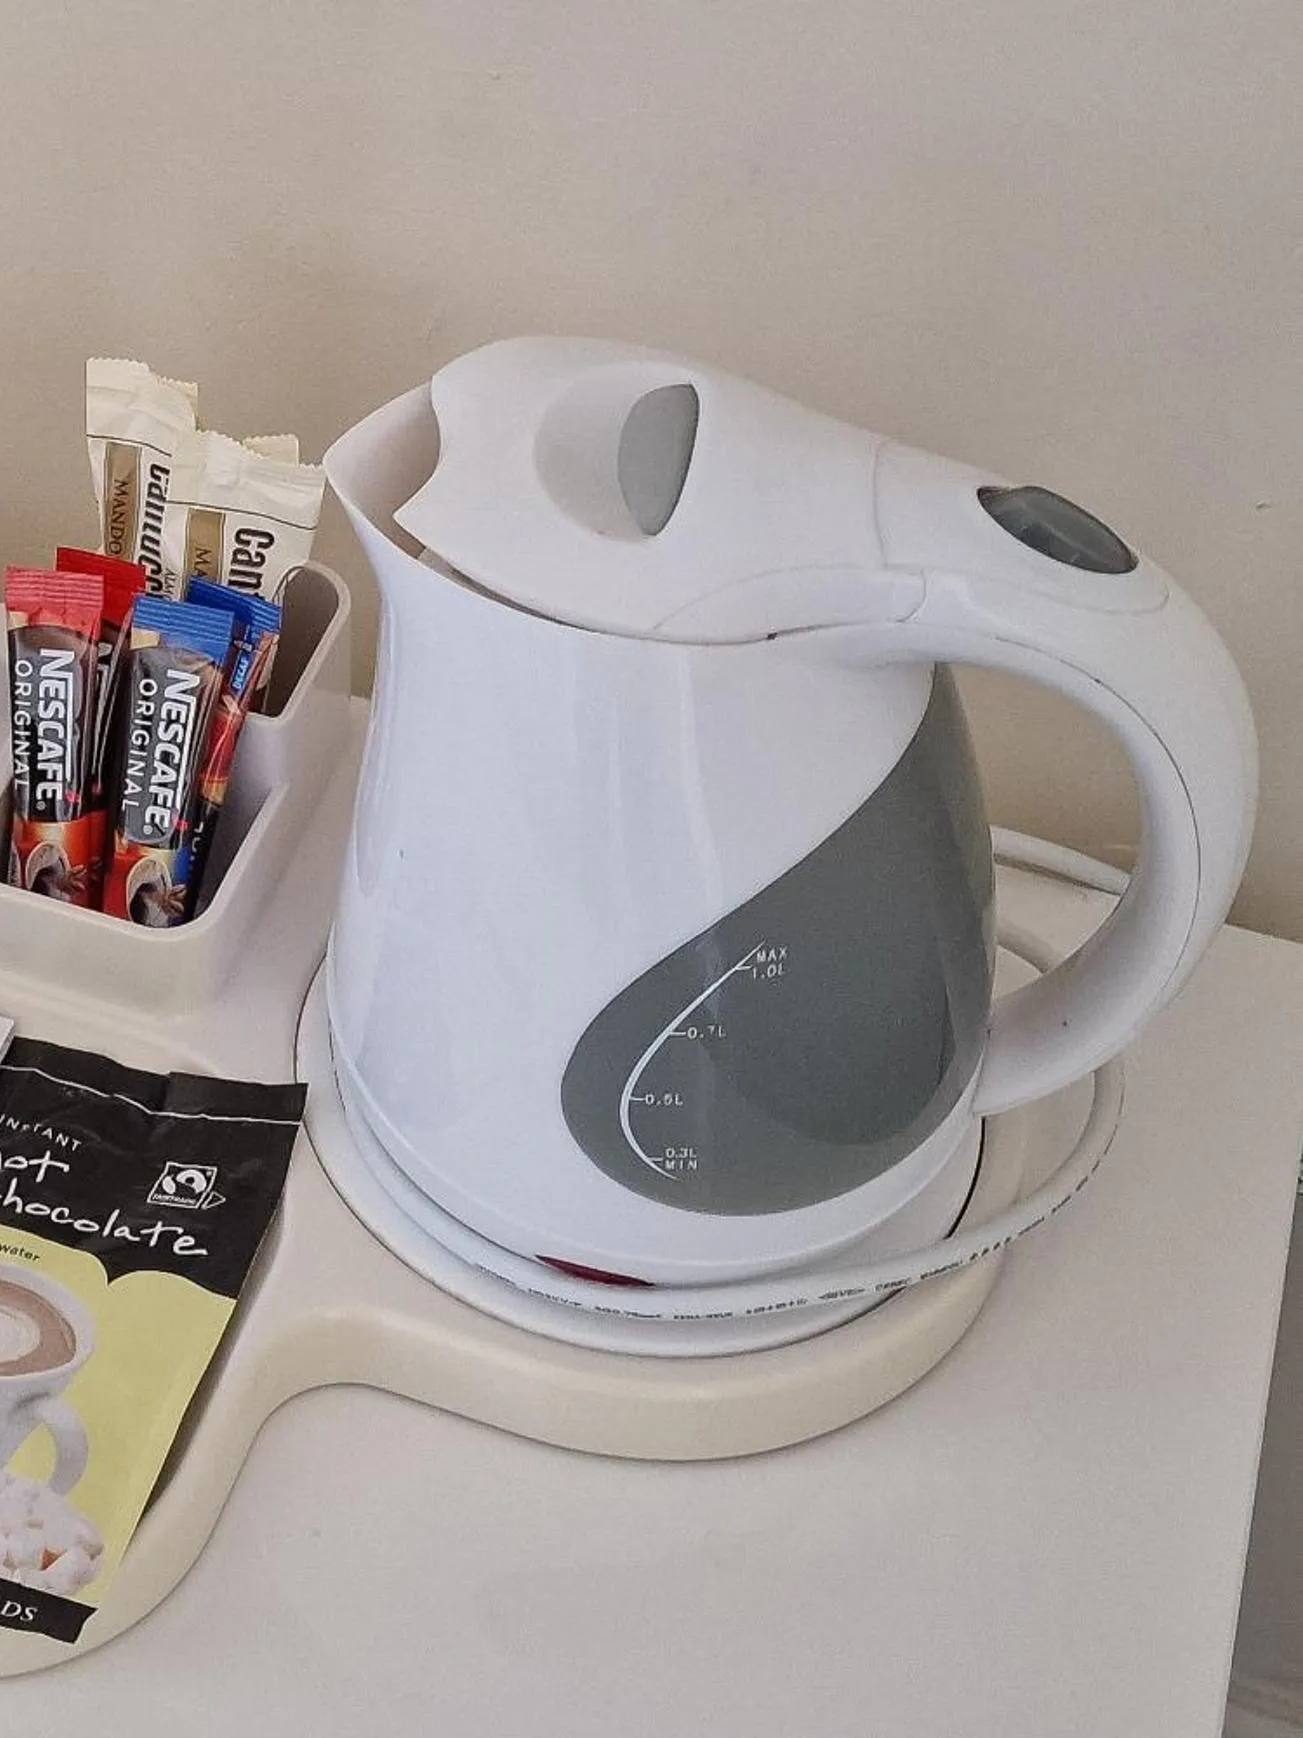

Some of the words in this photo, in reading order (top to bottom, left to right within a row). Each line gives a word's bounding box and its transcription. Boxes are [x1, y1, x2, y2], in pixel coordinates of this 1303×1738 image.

[12, 659, 34, 790] ORIGINAL
[122, 678, 159, 812] ORIGINAL
[756, 946, 788, 963] MAX
[752, 963, 785, 980] 1.0L
[665, 1159, 698, 1170] MIN
